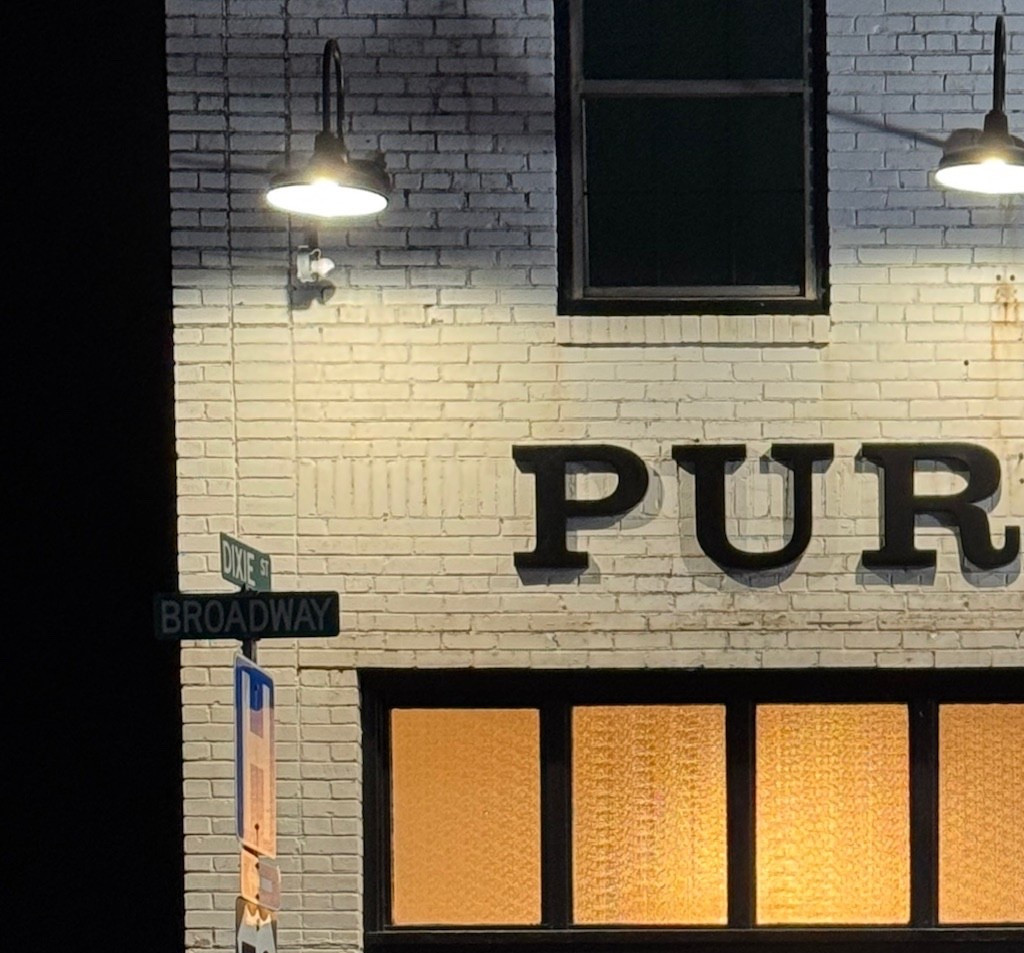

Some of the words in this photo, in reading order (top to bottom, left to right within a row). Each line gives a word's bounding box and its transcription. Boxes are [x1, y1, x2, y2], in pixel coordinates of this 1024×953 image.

[222, 541, 256, 587] DIXIE
[260, 559, 270, 577] ST
[160, 598, 332, 634] BROADWAY
